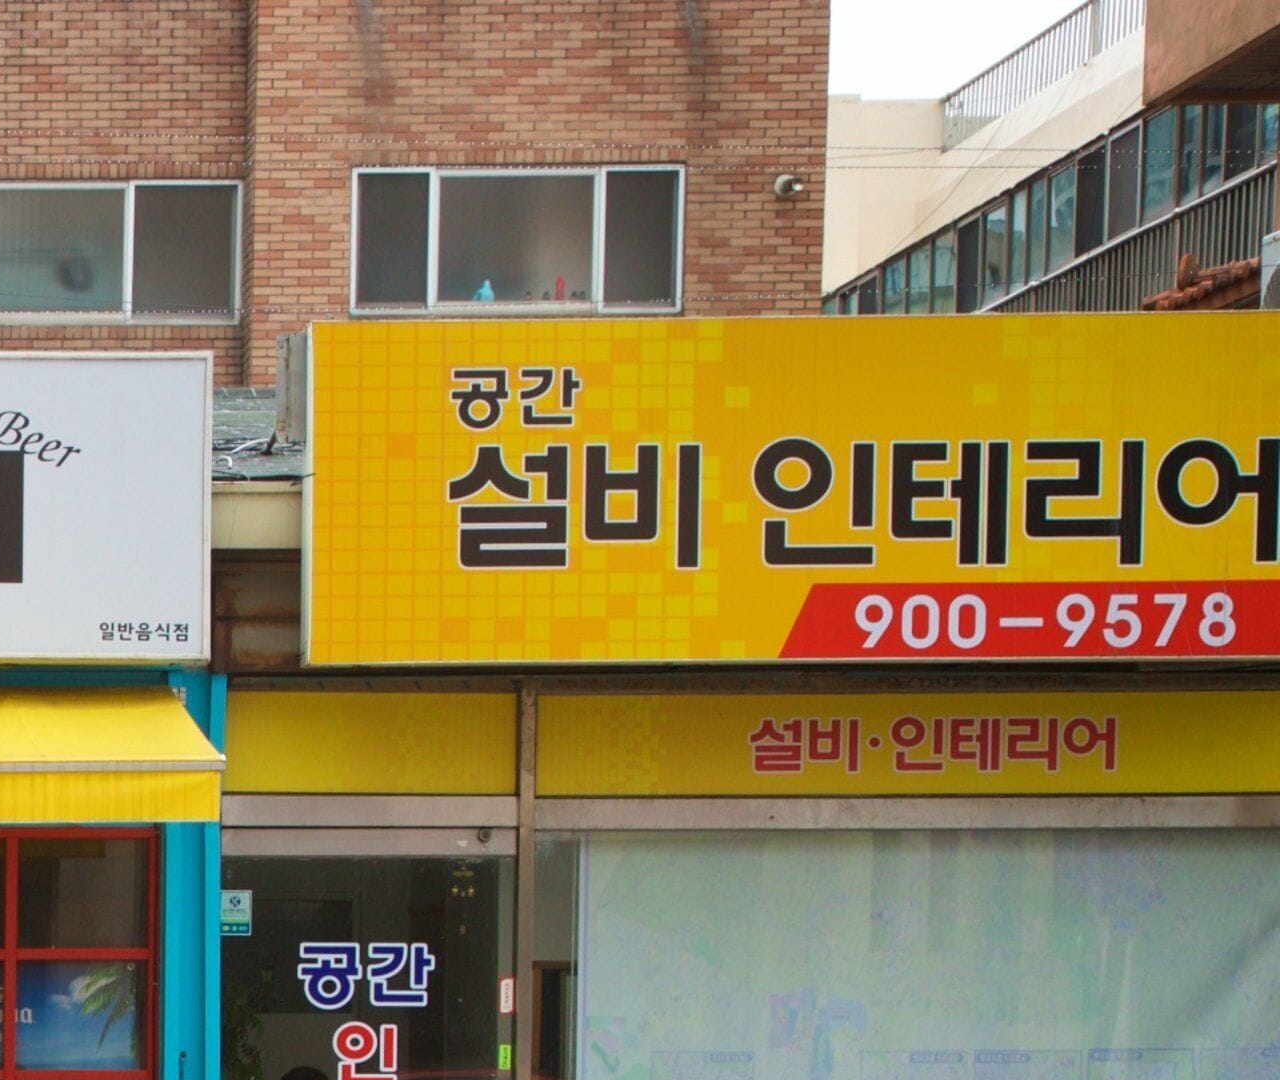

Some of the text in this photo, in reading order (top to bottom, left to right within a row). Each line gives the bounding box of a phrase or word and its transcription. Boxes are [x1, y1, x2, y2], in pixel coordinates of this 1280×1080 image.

[450, 367, 582, 431] 공간
[447, 435, 1280, 571] 설비 인테리어
[98, 620, 190, 642] 일반음식점
[854, 592, 1237, 650] 900-9578
[297, 942, 435, 1010] 공간
